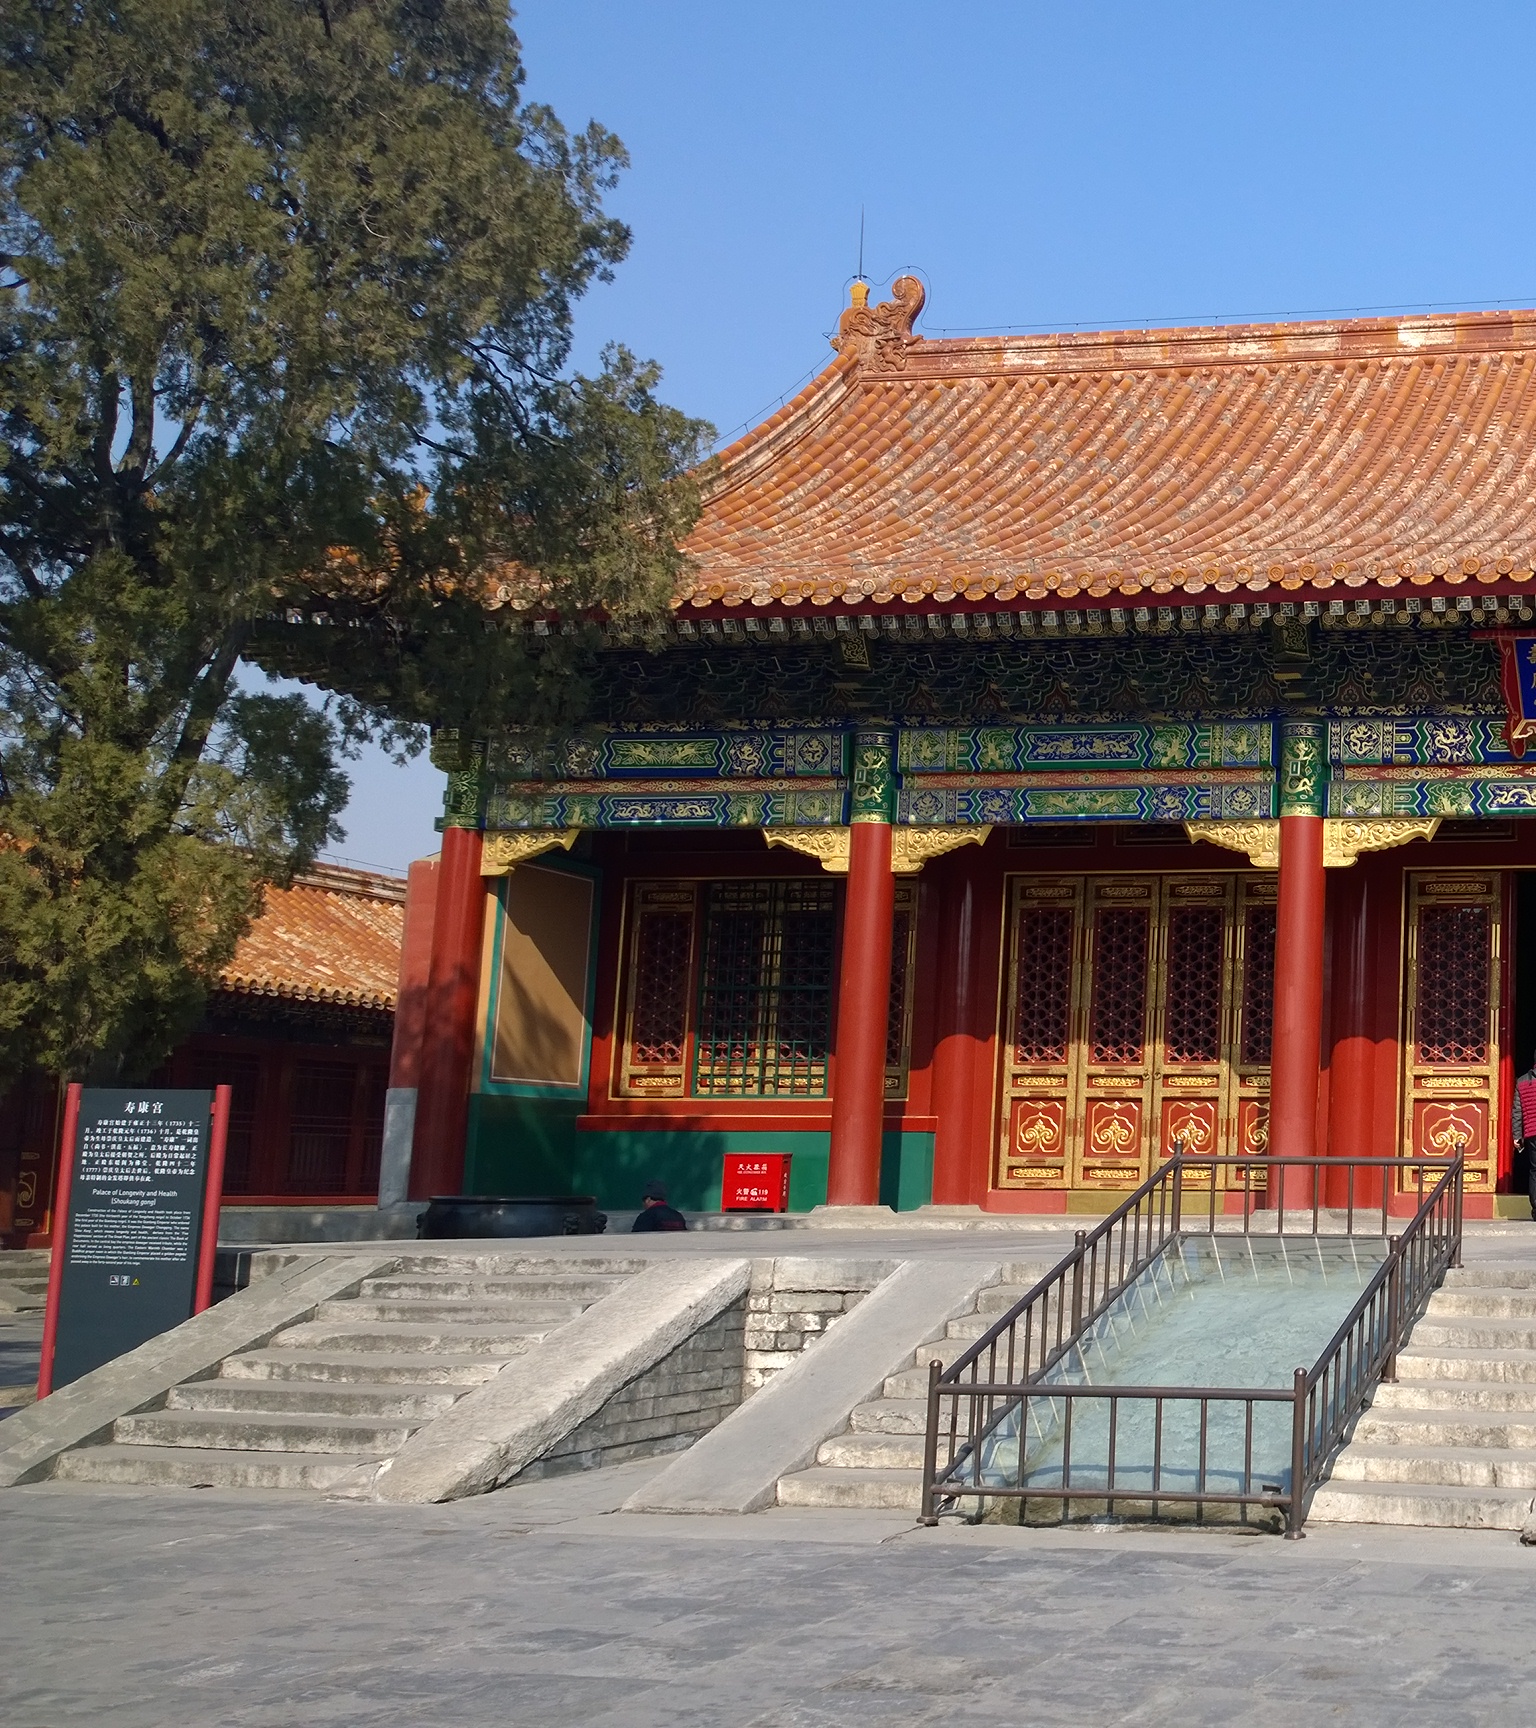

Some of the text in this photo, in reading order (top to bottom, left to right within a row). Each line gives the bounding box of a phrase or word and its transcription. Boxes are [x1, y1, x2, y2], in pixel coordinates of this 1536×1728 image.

[124, 1101, 164, 1114] 寿康宫
[119, 1189, 146, 1197] Longevity
